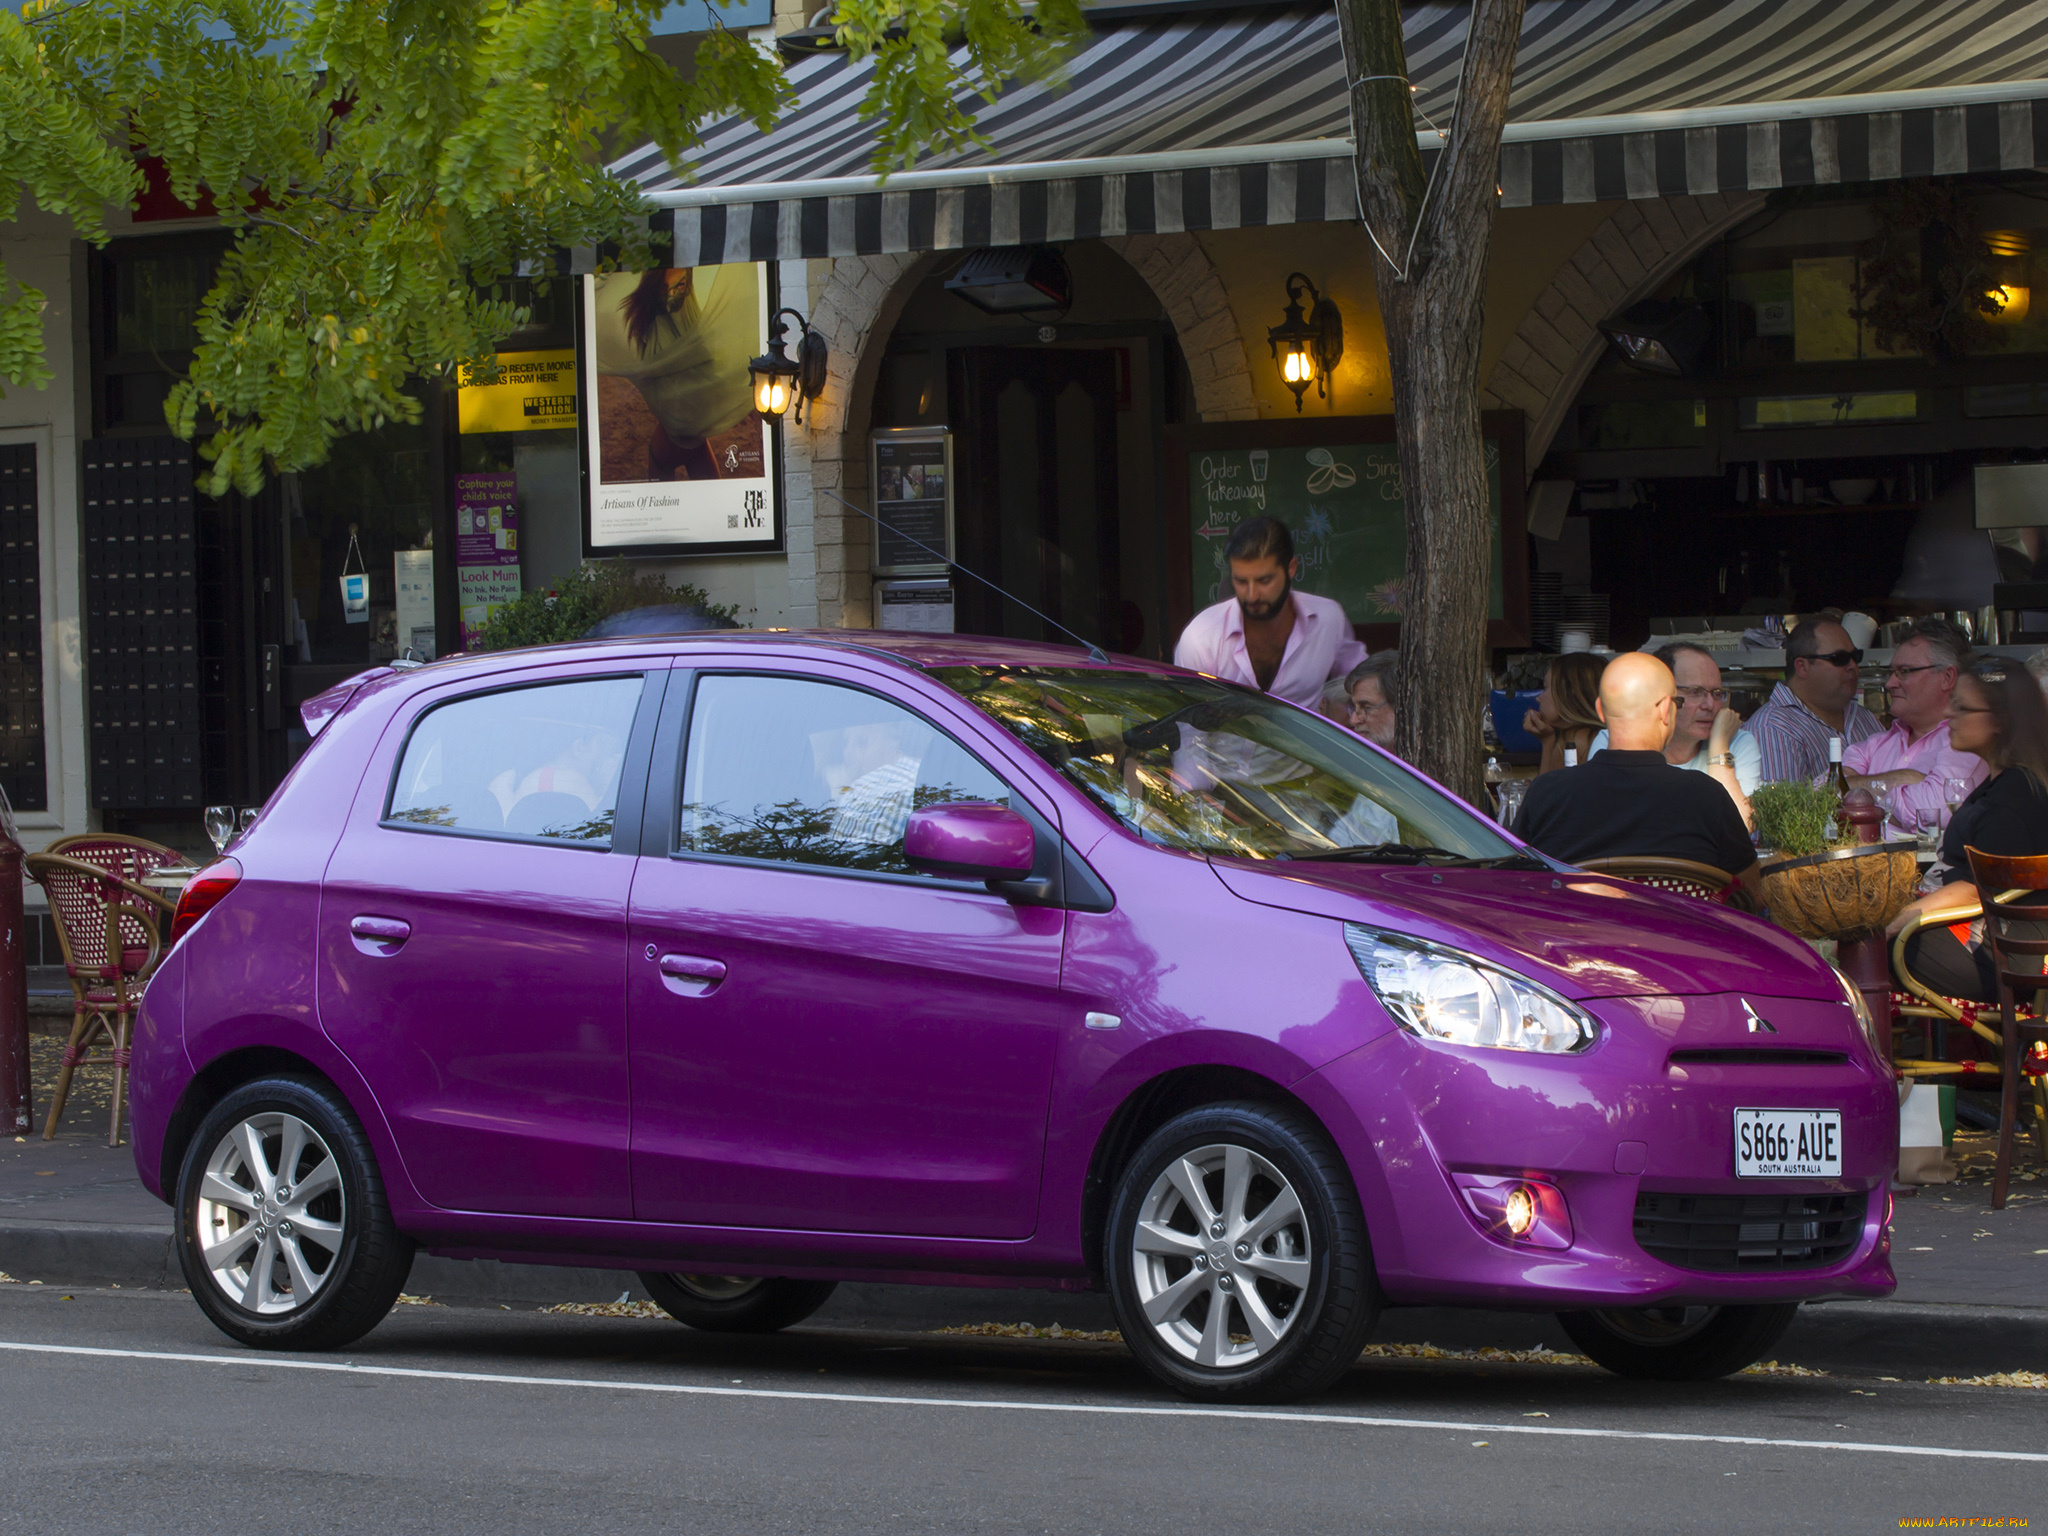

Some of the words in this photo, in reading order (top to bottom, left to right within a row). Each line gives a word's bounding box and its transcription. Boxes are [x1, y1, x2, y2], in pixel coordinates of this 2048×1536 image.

[509, 363, 544, 374] RECEIVE
[510, 375, 534, 384] FROM
[536, 372, 558, 382] HERE
[524, 396, 571, 407] WESTERN
[539, 406, 571, 415] UNION
[1200, 456, 1242, 480] Order
[458, 480, 494, 490] Capture
[496, 480, 514, 490] your
[462, 491, 486, 501] child's
[490, 490, 512, 500] voice
[1202, 482, 1266, 510] Takeaway
[600, 498, 635, 510] Artisans
[636, 496, 648, 510] Of
[648, 496, 680, 507] Fashion
[1209, 505, 1241, 526] here
[461, 570, 489, 582] Look
[492, 570, 518, 582] Mum
[462, 586, 473, 594] No
[476, 594, 488, 602] No
[1758, 1164, 1781, 1173] SOUTH
[1784, 1164, 1822, 1174] AUSTRALIA
